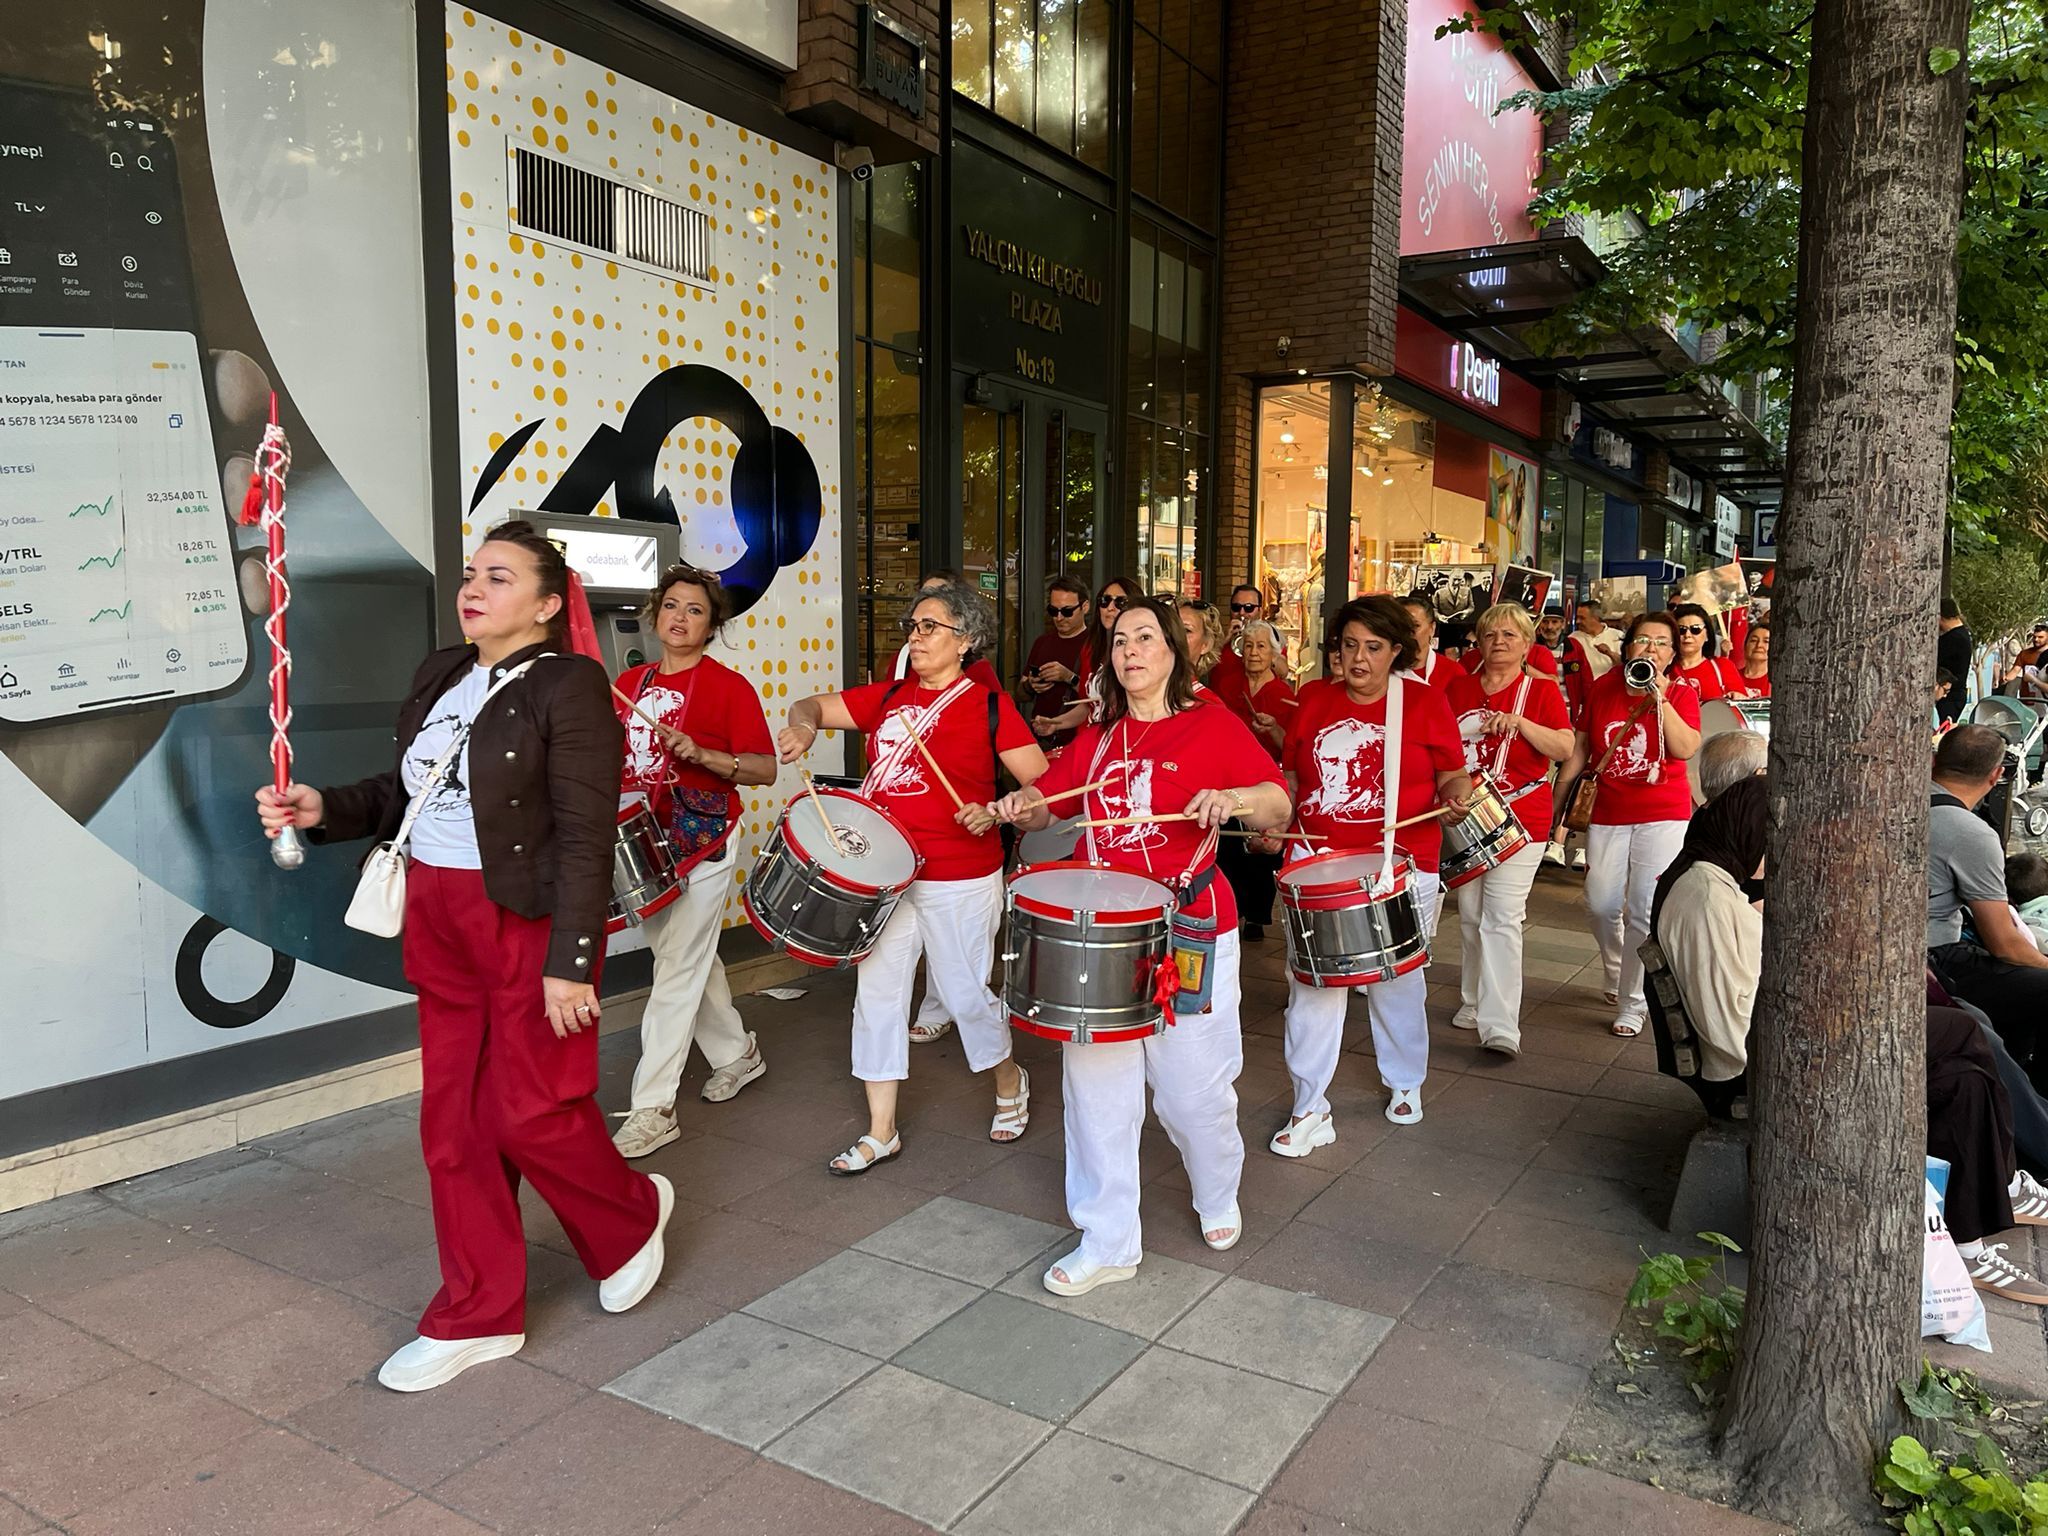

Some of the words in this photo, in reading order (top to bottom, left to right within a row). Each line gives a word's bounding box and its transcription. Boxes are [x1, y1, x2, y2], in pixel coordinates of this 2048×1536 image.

[0, 144, 43, 160] ynep!
[1418, 136, 1460, 237] SENİN
[1462, 142, 1488, 208] HER
[15, 201, 31, 213] TL
[61, 277, 79, 285] Para
[1010, 290, 1063, 335] PLAZA
[0, 359, 26, 369] TAN
[1015, 347, 1056, 385] No:13
[1463, 341, 1501, 408] Penti
[5, 393, 54, 406] kopyala,
[56, 393, 96, 403] hesaba
[98, 394, 123, 405] para
[124, 393, 163, 405] gönder
[8, 415, 37, 427] 5678
[39, 415, 66, 426] 1234
[67, 414, 96, 425] 5678
[98, 414, 123, 424] 1234
[124, 414, 139, 424] 00
[197, 490, 209, 500] TL
[177, 541, 204, 553] 18,26
[205, 540, 217, 550] TL
[586, 553, 629, 566] odeabank
[185, 591, 212, 603] 72,05
[213, 589, 226, 599] TL
[208, 660, 226, 669] Daha
[8, 688, 32, 699] Sayfa
